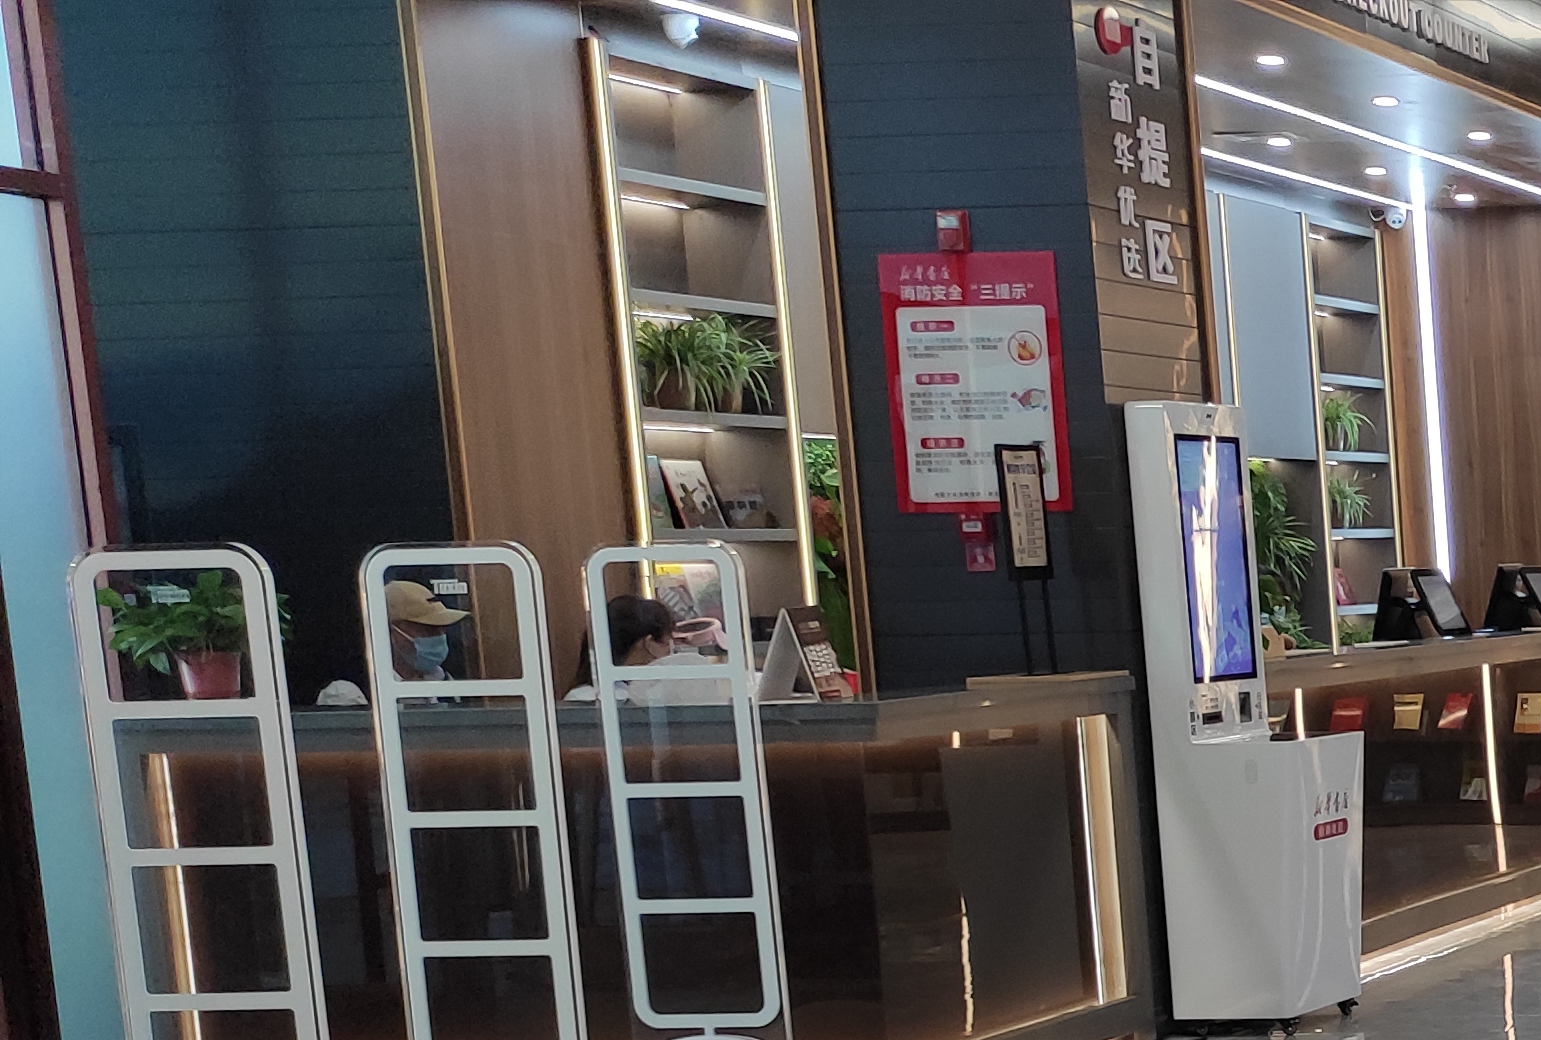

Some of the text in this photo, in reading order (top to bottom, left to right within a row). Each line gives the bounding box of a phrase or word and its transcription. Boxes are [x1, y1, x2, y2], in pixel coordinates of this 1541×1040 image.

[1421, 9, 1490, 63] COUNTER
[1132, 18, 1178, 284] 自提区
